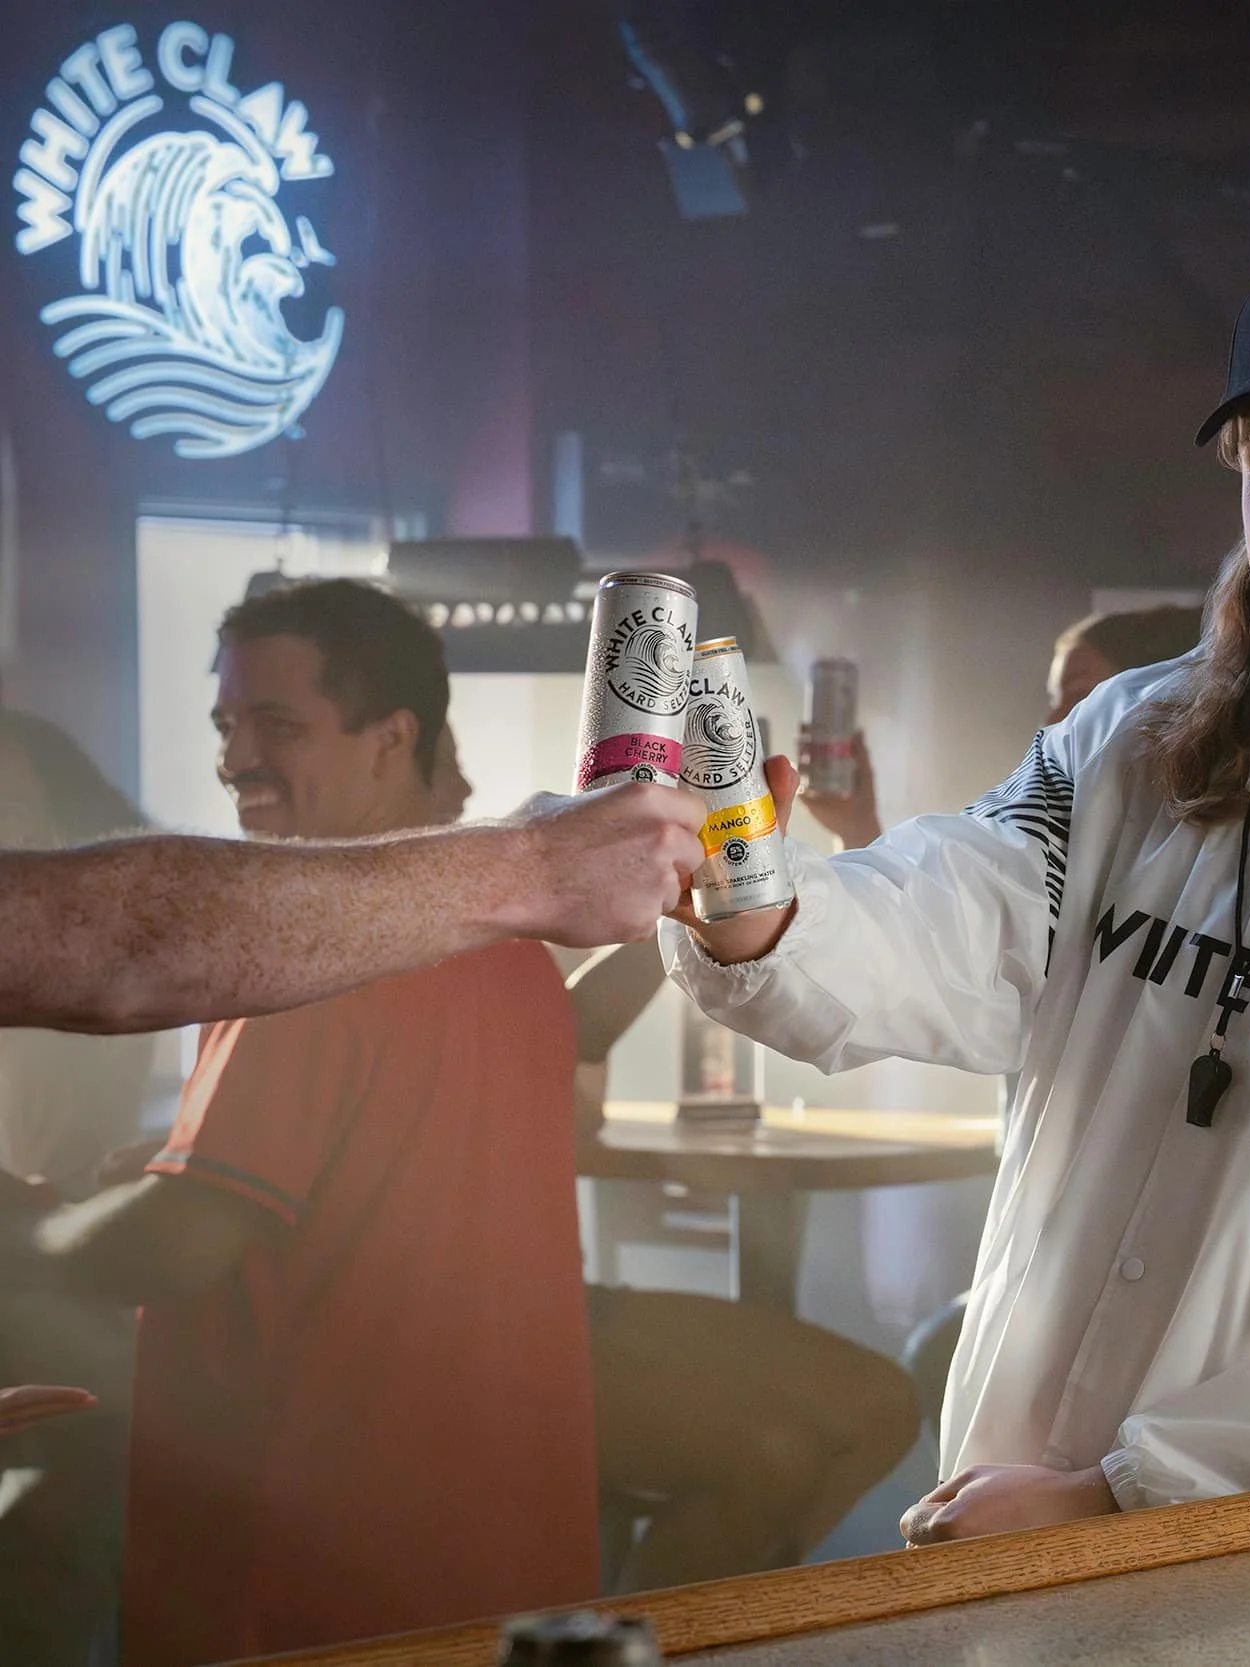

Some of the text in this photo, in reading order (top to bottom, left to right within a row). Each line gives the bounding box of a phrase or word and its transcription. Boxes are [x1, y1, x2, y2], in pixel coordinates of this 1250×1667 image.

[12, 20, 335, 255] WHITE CLAW
[605, 606, 693, 673] WHITE CLAW
[618, 681, 656, 708] HARD
[688, 677, 745, 707] CLAW
[625, 747, 668, 763] CHERRY
[630, 737, 666, 753] BLACK
[683, 766, 723, 784] HARD
[708, 816, 751, 832] MANGO
